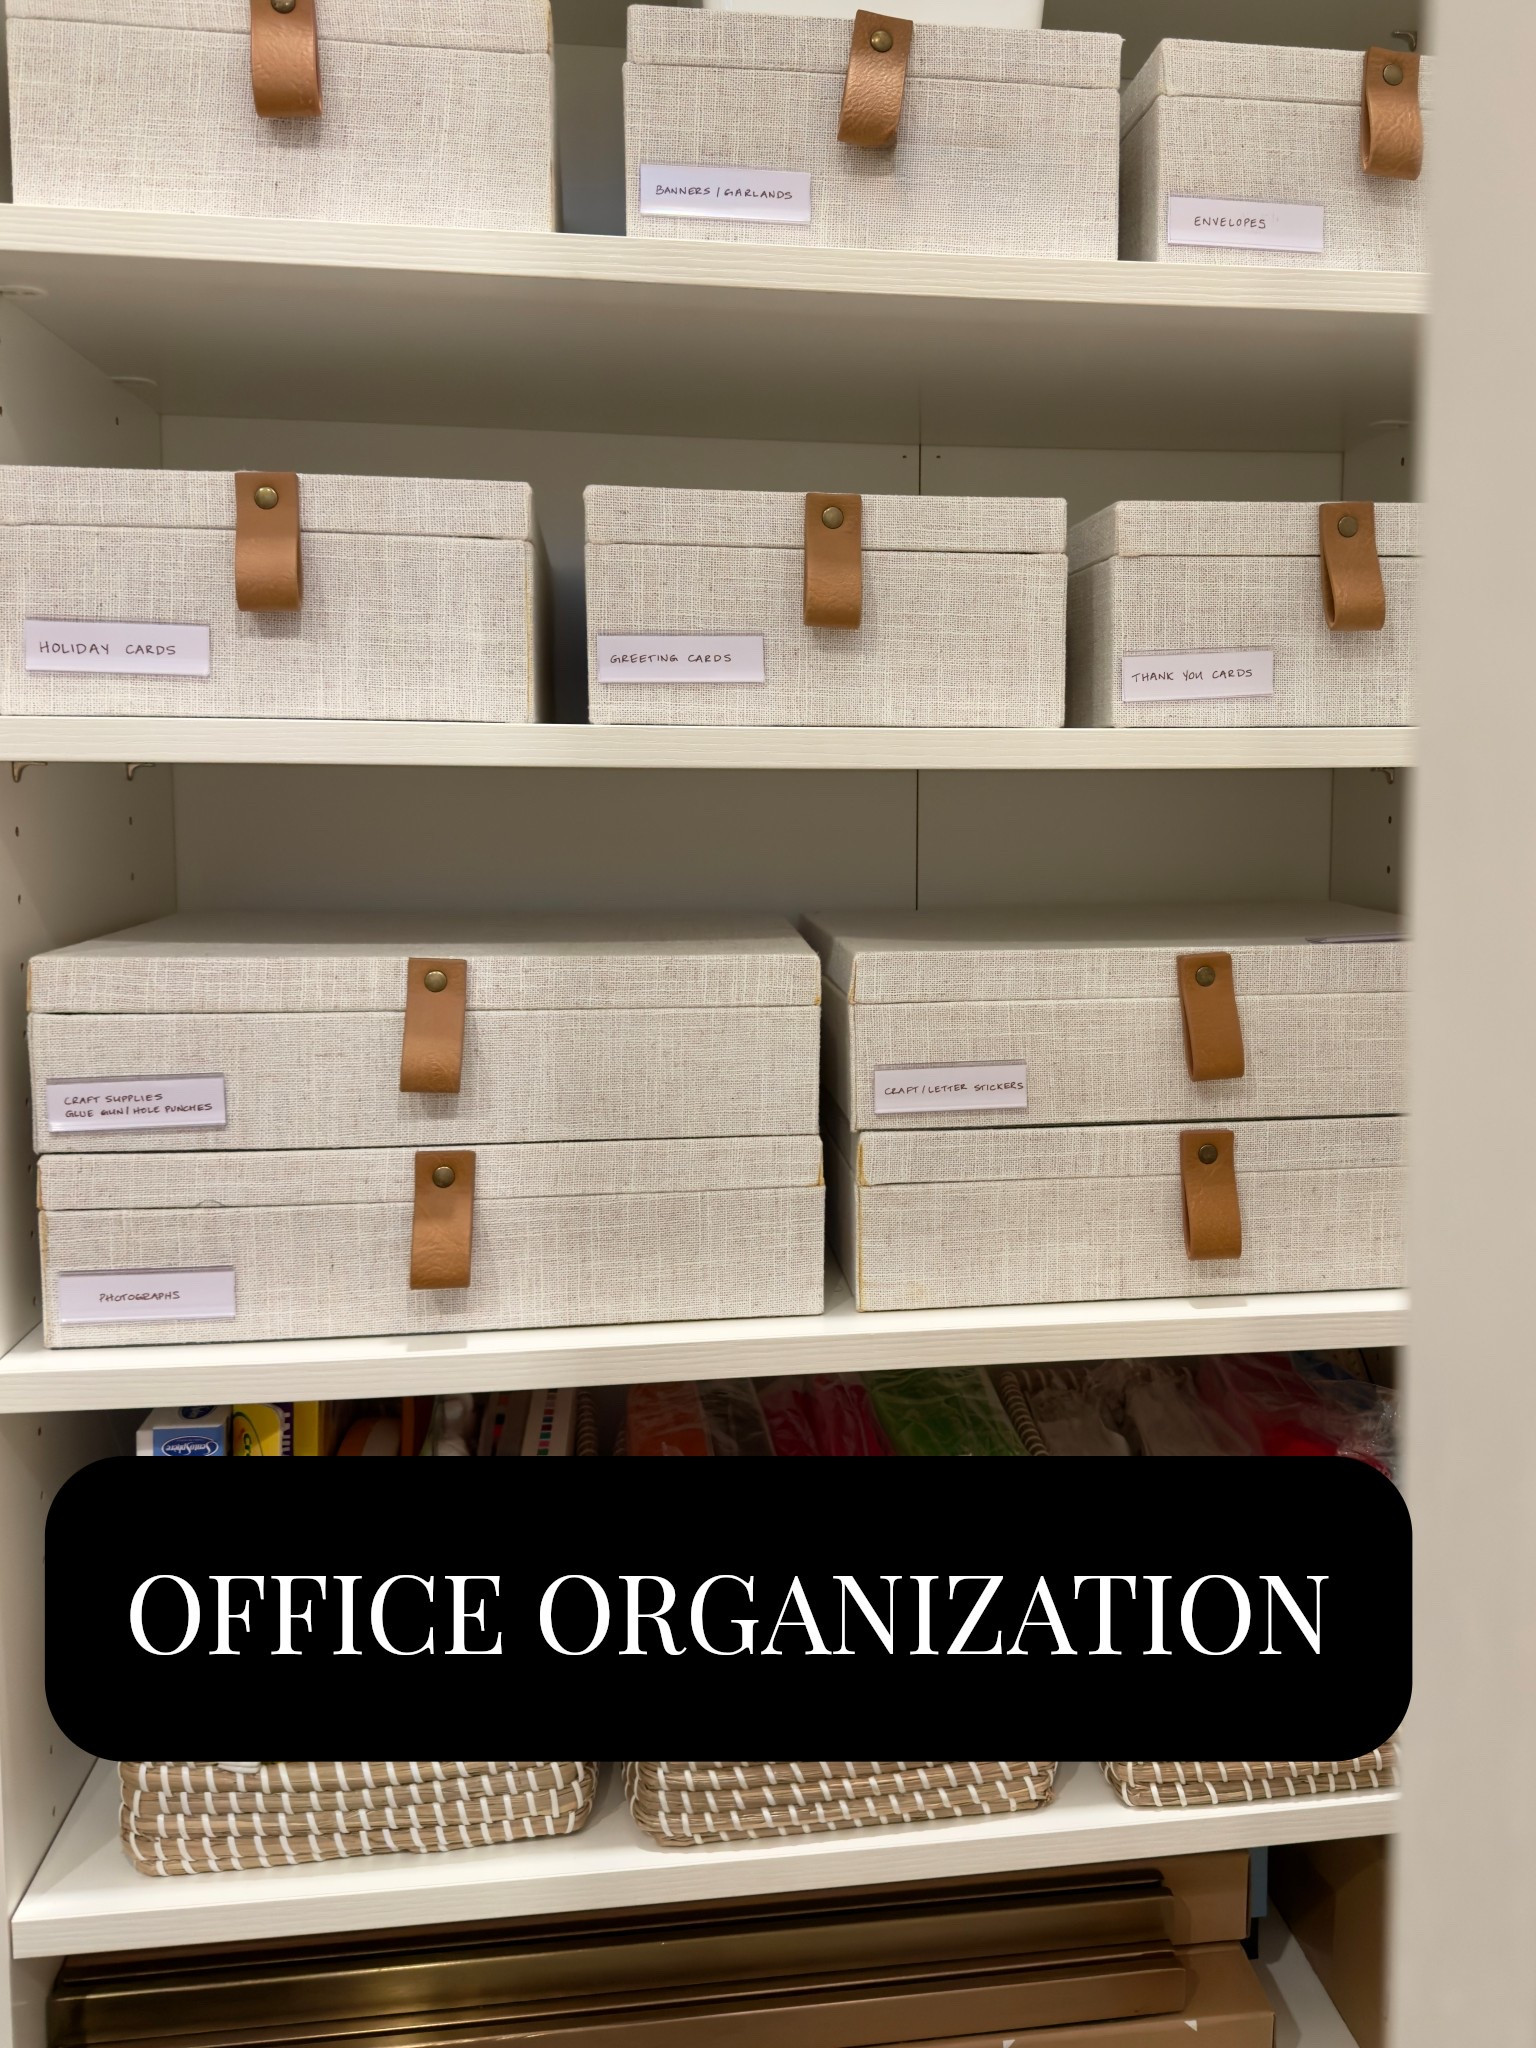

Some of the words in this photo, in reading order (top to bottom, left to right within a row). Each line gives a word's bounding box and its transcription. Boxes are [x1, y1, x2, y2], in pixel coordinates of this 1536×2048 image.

[1194, 216, 1266, 229] ENVELOPES
[39, 641, 110, 656] HOLIDAY
[125, 644, 177, 656] CARDS
[610, 653, 679, 664] GREETING
[687, 653, 732, 663] CARDS
[1131, 671, 1175, 683] THANK
[1182, 669, 1204, 682] YOU
[1212, 668, 1253, 679] CARDS
[973, 1081, 1024, 1092] STICKERS
[64, 1095, 101, 1106] CRAFT
[105, 1093, 164, 1104] SUPPLIES
[65, 1109, 94, 1119] GLUE
[165, 1103, 213, 1114] PUNCHES
[98, 1290, 181, 1303] PHOTOGRAPHS
